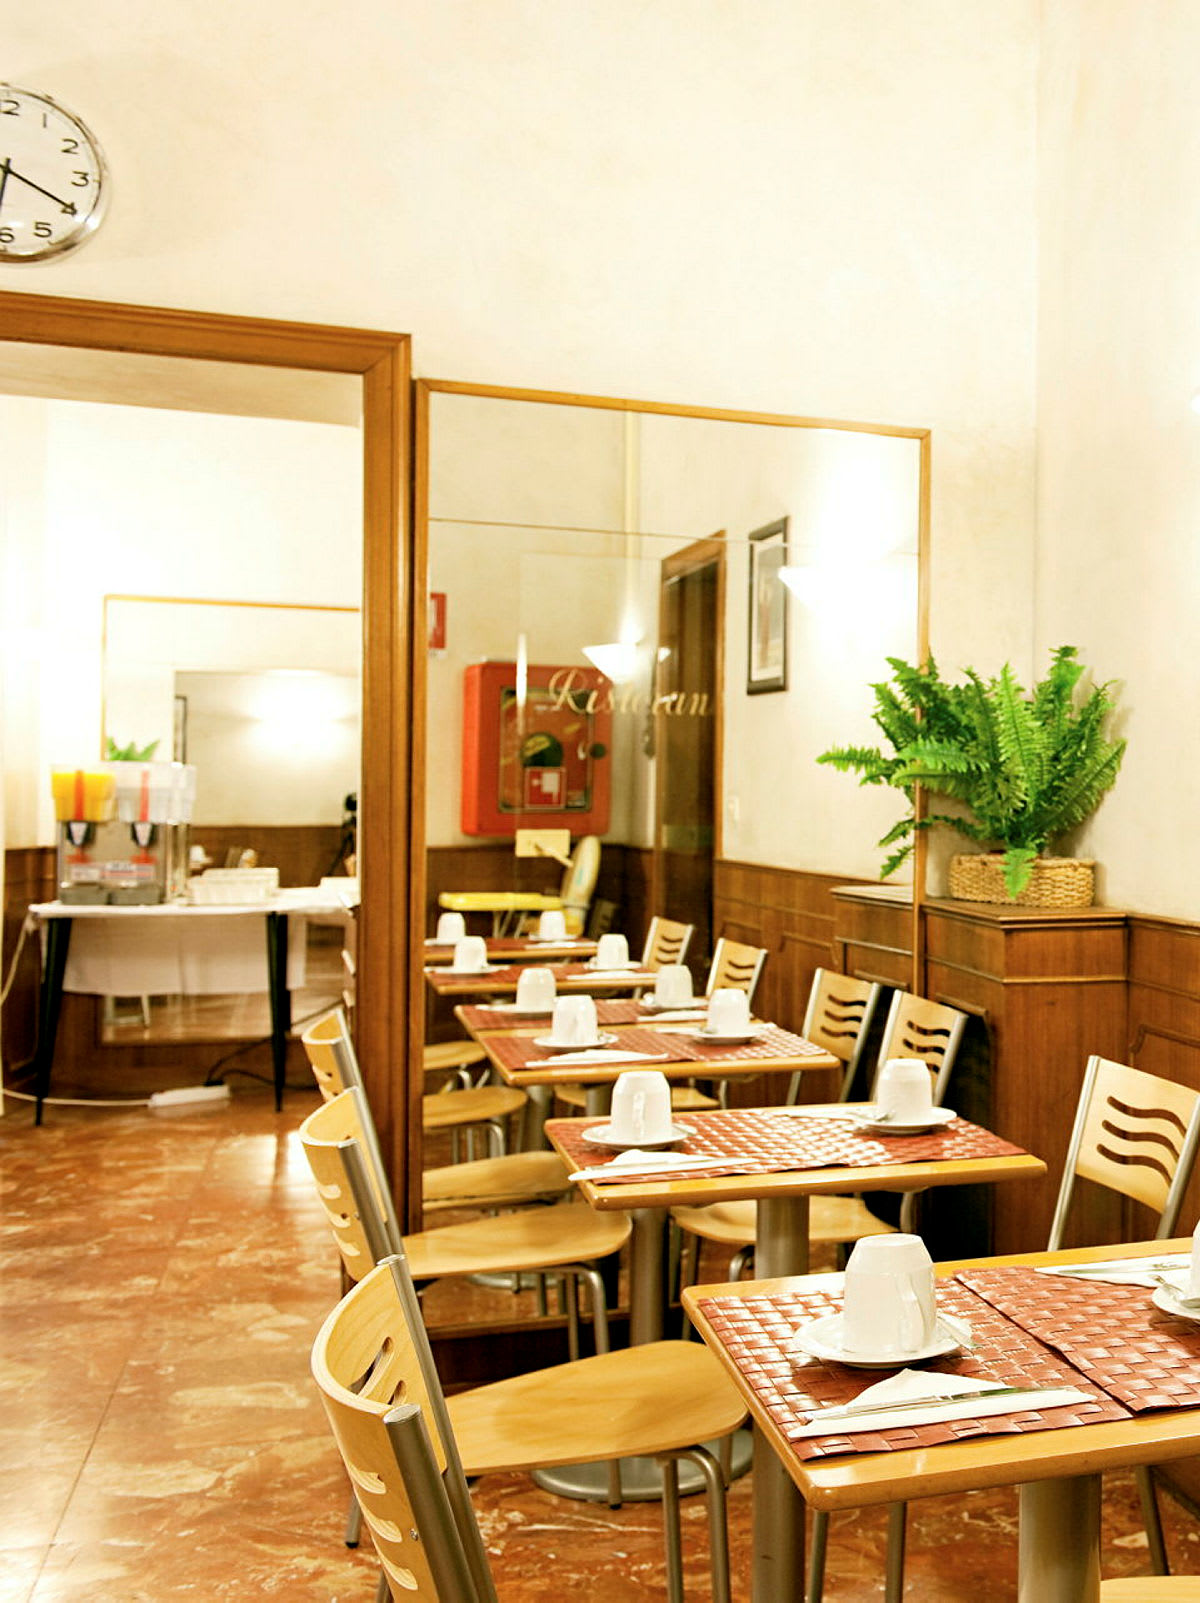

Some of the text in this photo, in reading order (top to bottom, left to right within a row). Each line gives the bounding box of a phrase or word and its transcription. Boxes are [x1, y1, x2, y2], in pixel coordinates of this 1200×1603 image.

[0, 99, 20, 116] 2
[42, 112, 48, 129] 1
[61, 138, 79, 155] 2
[70, 171, 90, 188] 3
[33, 221, 53, 238] 5
